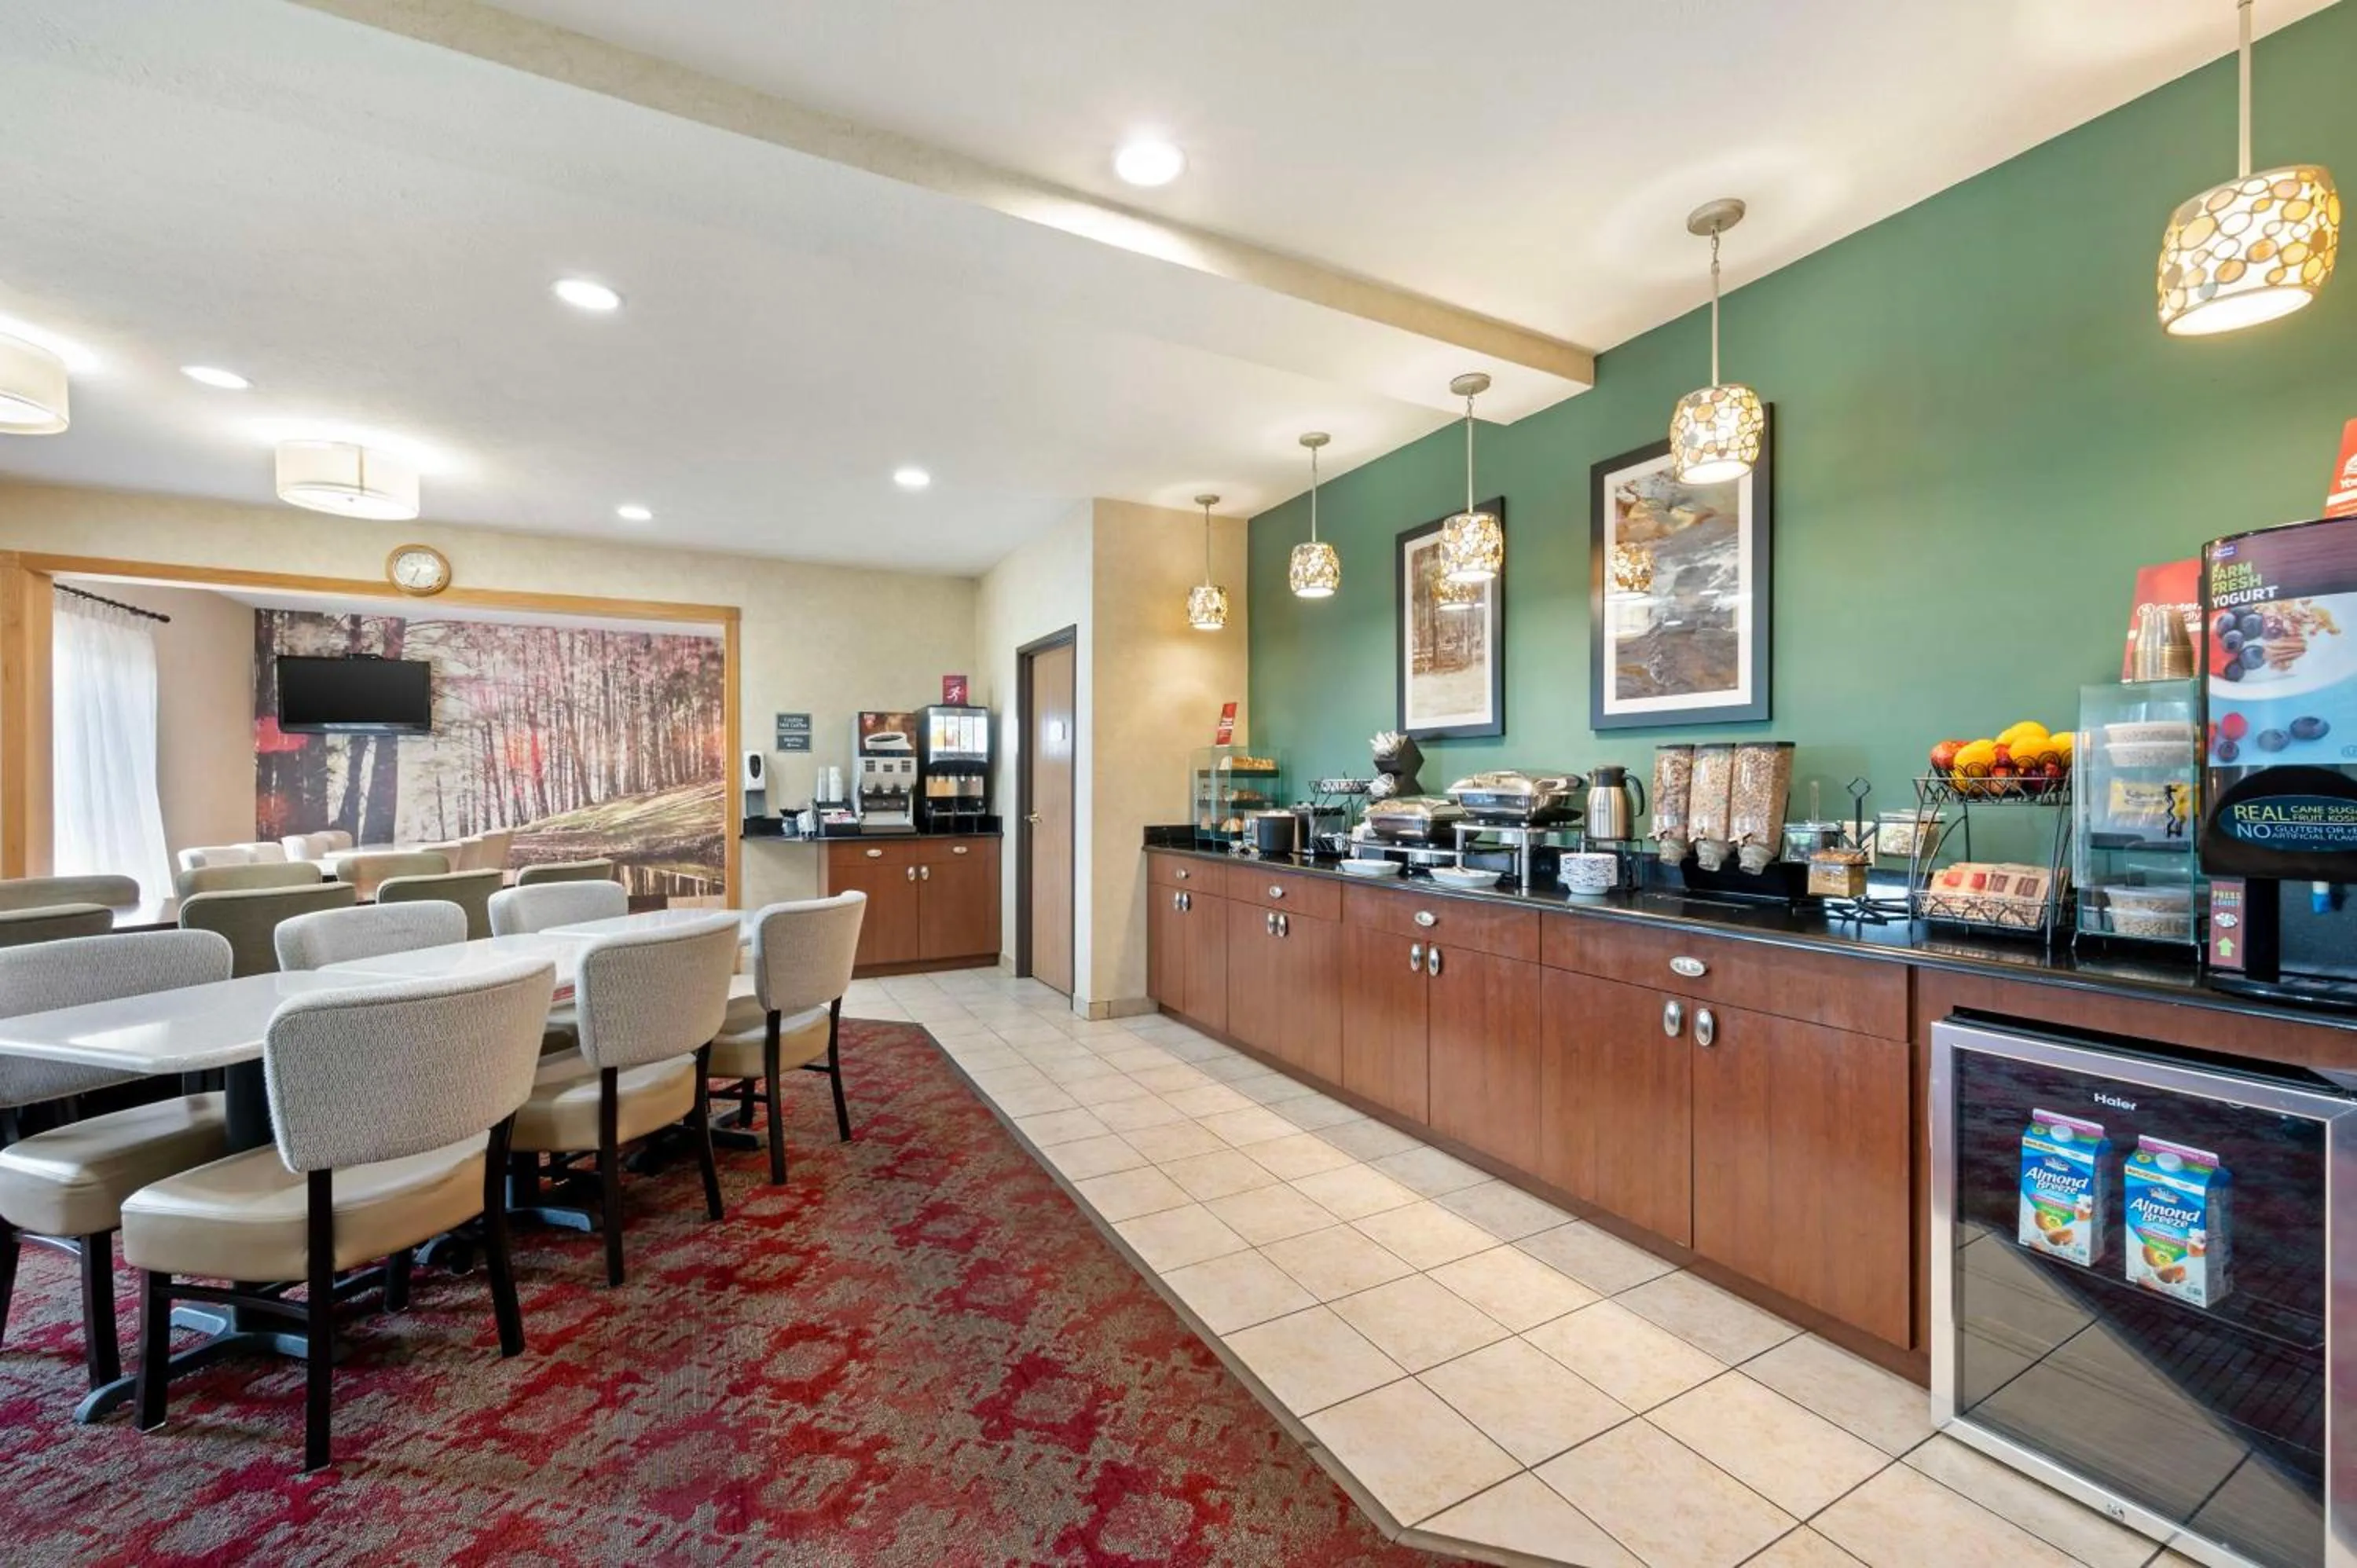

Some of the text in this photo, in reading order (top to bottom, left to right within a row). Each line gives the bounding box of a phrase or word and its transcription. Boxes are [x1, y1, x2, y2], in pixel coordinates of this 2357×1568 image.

[2212, 561, 2253, 581] FARM
[2212, 574, 2262, 595] FRESH
[2212, 584, 2279, 609] YOGURT
[2233, 804, 2290, 821] REAL
[2290, 805, 2325, 814] CANE
[2236, 822, 2271, 839] NO
[2271, 832, 2325, 841] ARTIFICIAL
[2275, 824, 2323, 833] GLUTEN
[2326, 825, 2344, 834] OR
[2094, 1092, 2137, 1111] Haier
[2025, 1167, 2089, 1189] Almond
[2036, 1180, 2078, 1195] Breeze
[2129, 1197, 2201, 1223] Almond
[2143, 1212, 2188, 1228] Breeze
